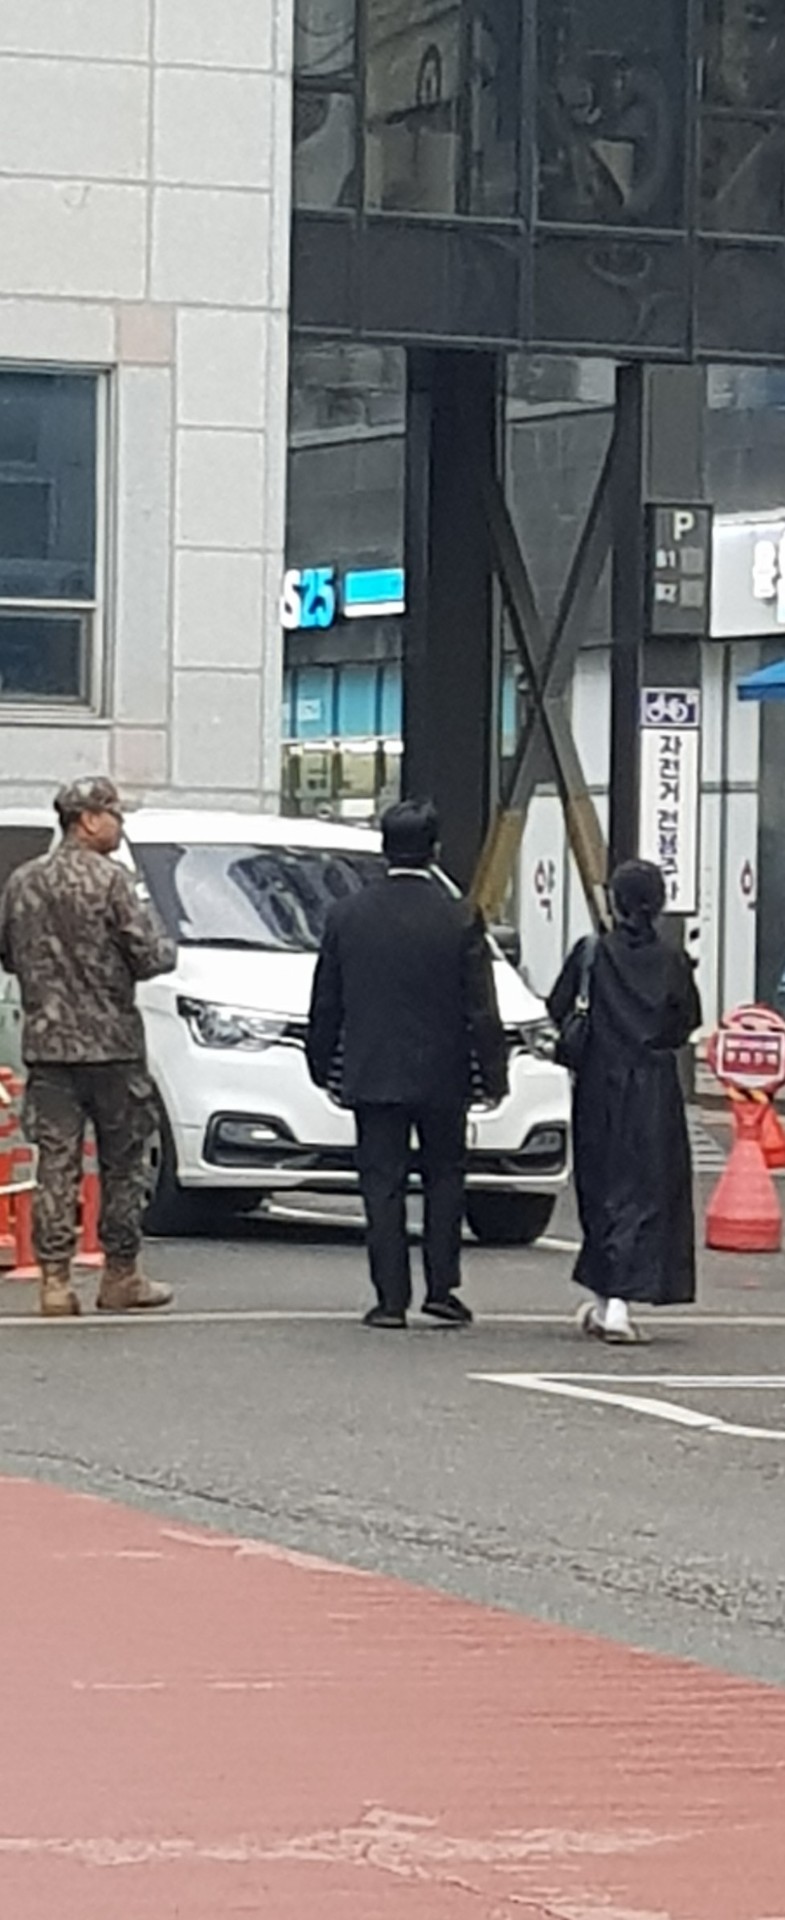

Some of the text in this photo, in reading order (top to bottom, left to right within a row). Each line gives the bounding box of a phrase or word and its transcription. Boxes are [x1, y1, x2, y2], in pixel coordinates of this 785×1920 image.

[673, 510, 694, 541] P
[655, 549, 676, 568] B1
[654, 582, 678, 603] B2
[658, 734, 683, 803] 자전거
[534, 859, 556, 922] 약
